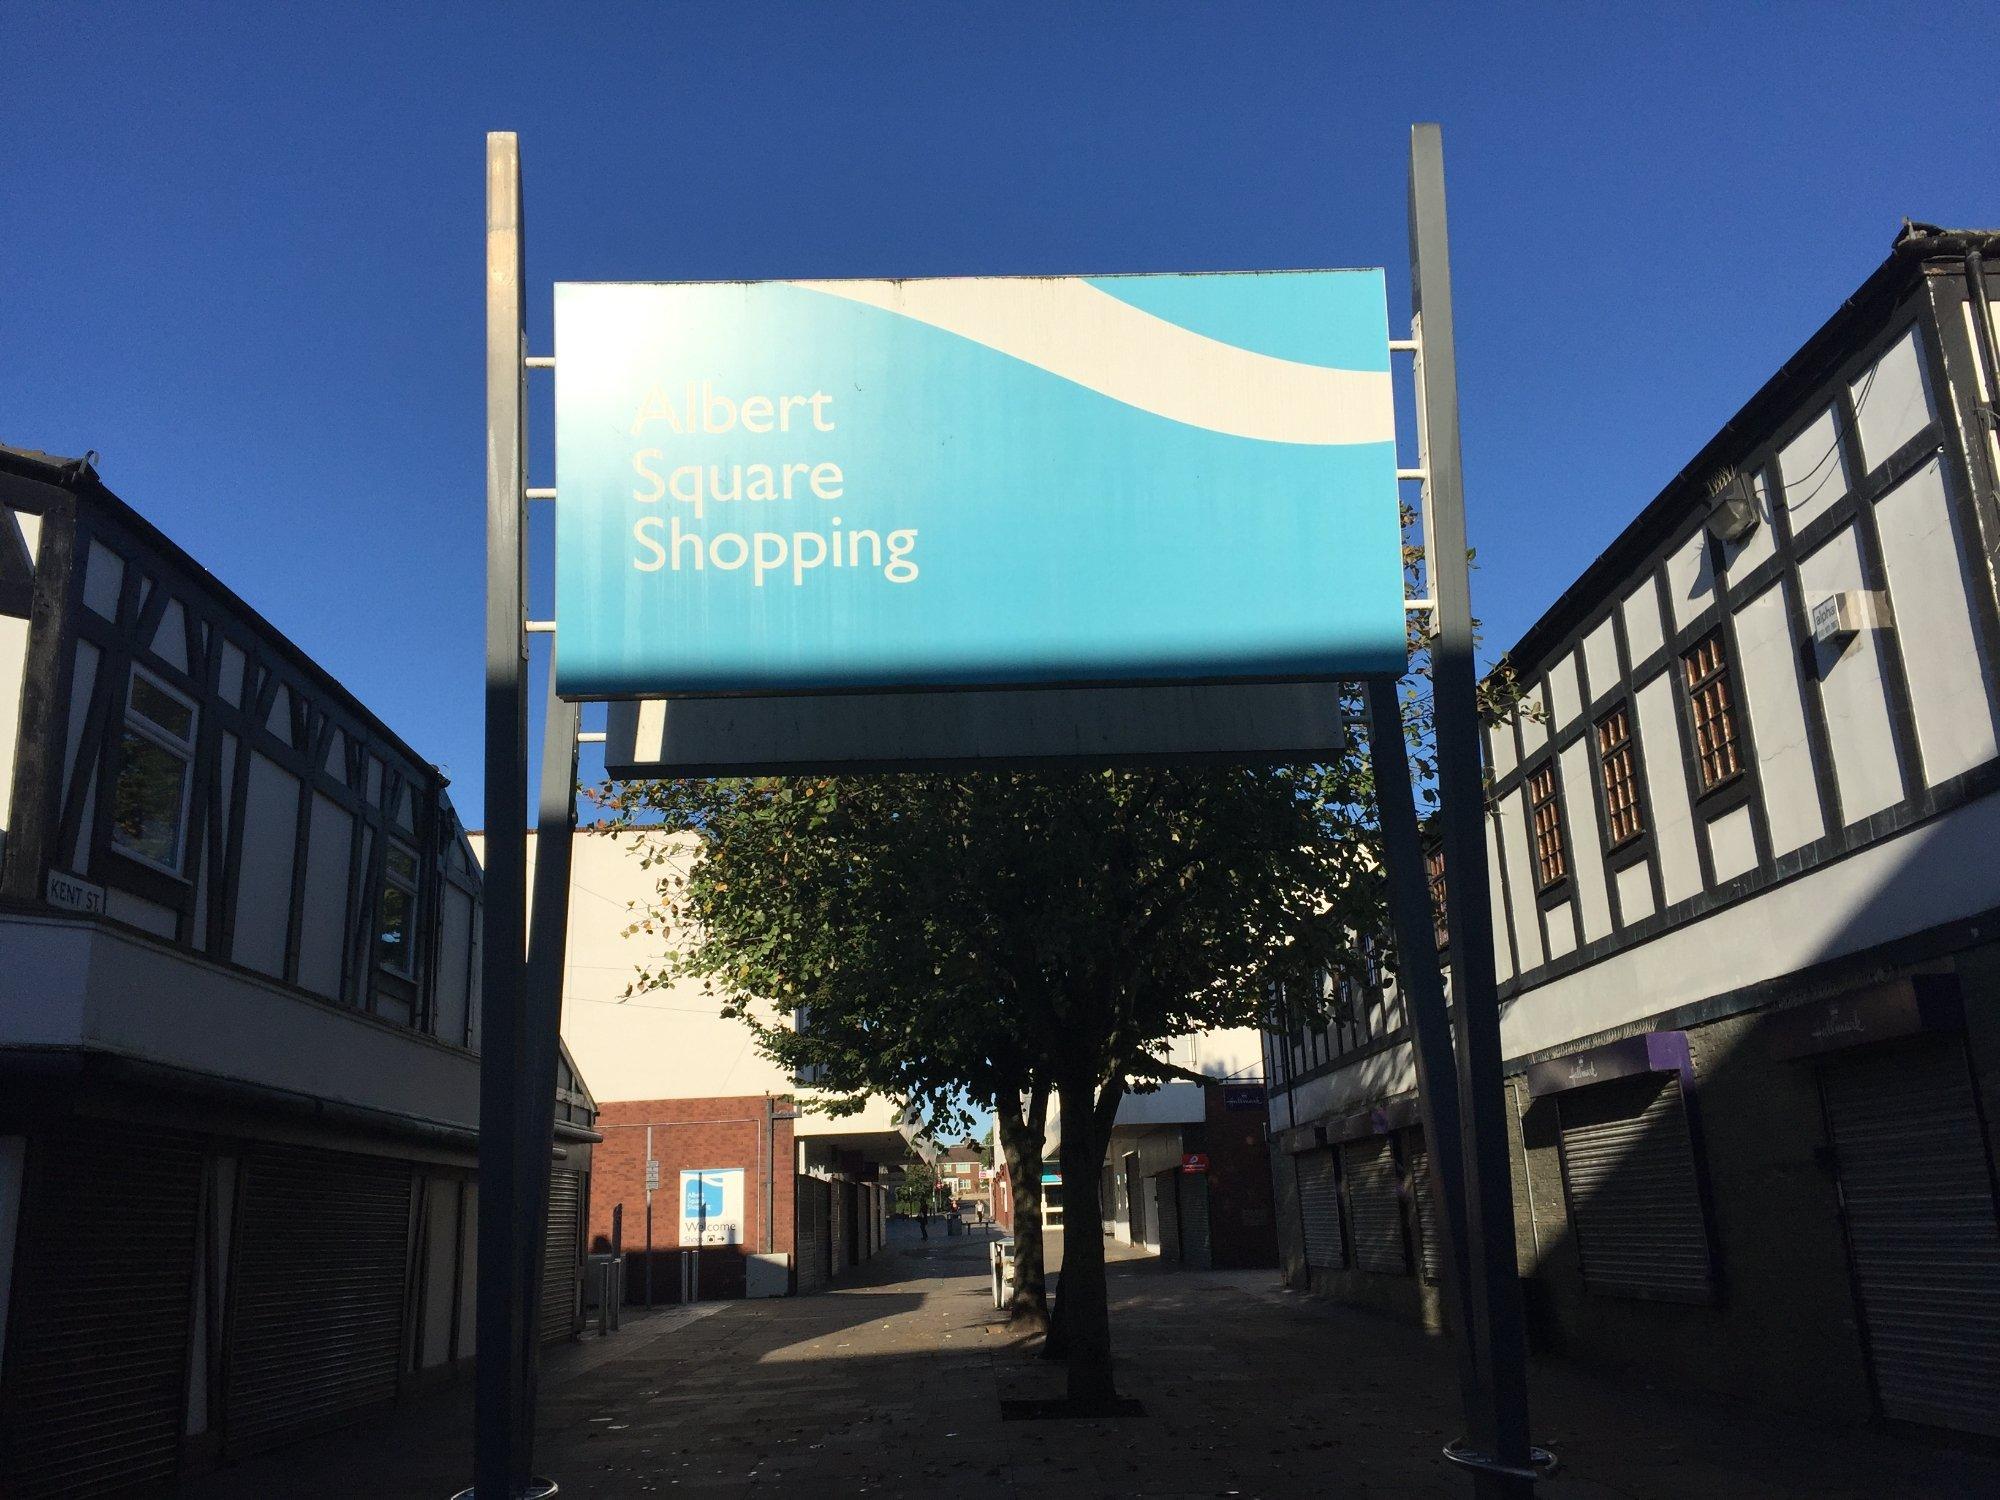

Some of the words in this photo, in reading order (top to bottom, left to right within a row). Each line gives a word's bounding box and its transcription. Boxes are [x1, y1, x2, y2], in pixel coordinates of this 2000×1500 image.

[631, 379, 836, 436] Albert
[631, 447, 844, 519] Square
[632, 515, 920, 587] Shopping
[51, 878, 83, 904] KENT
